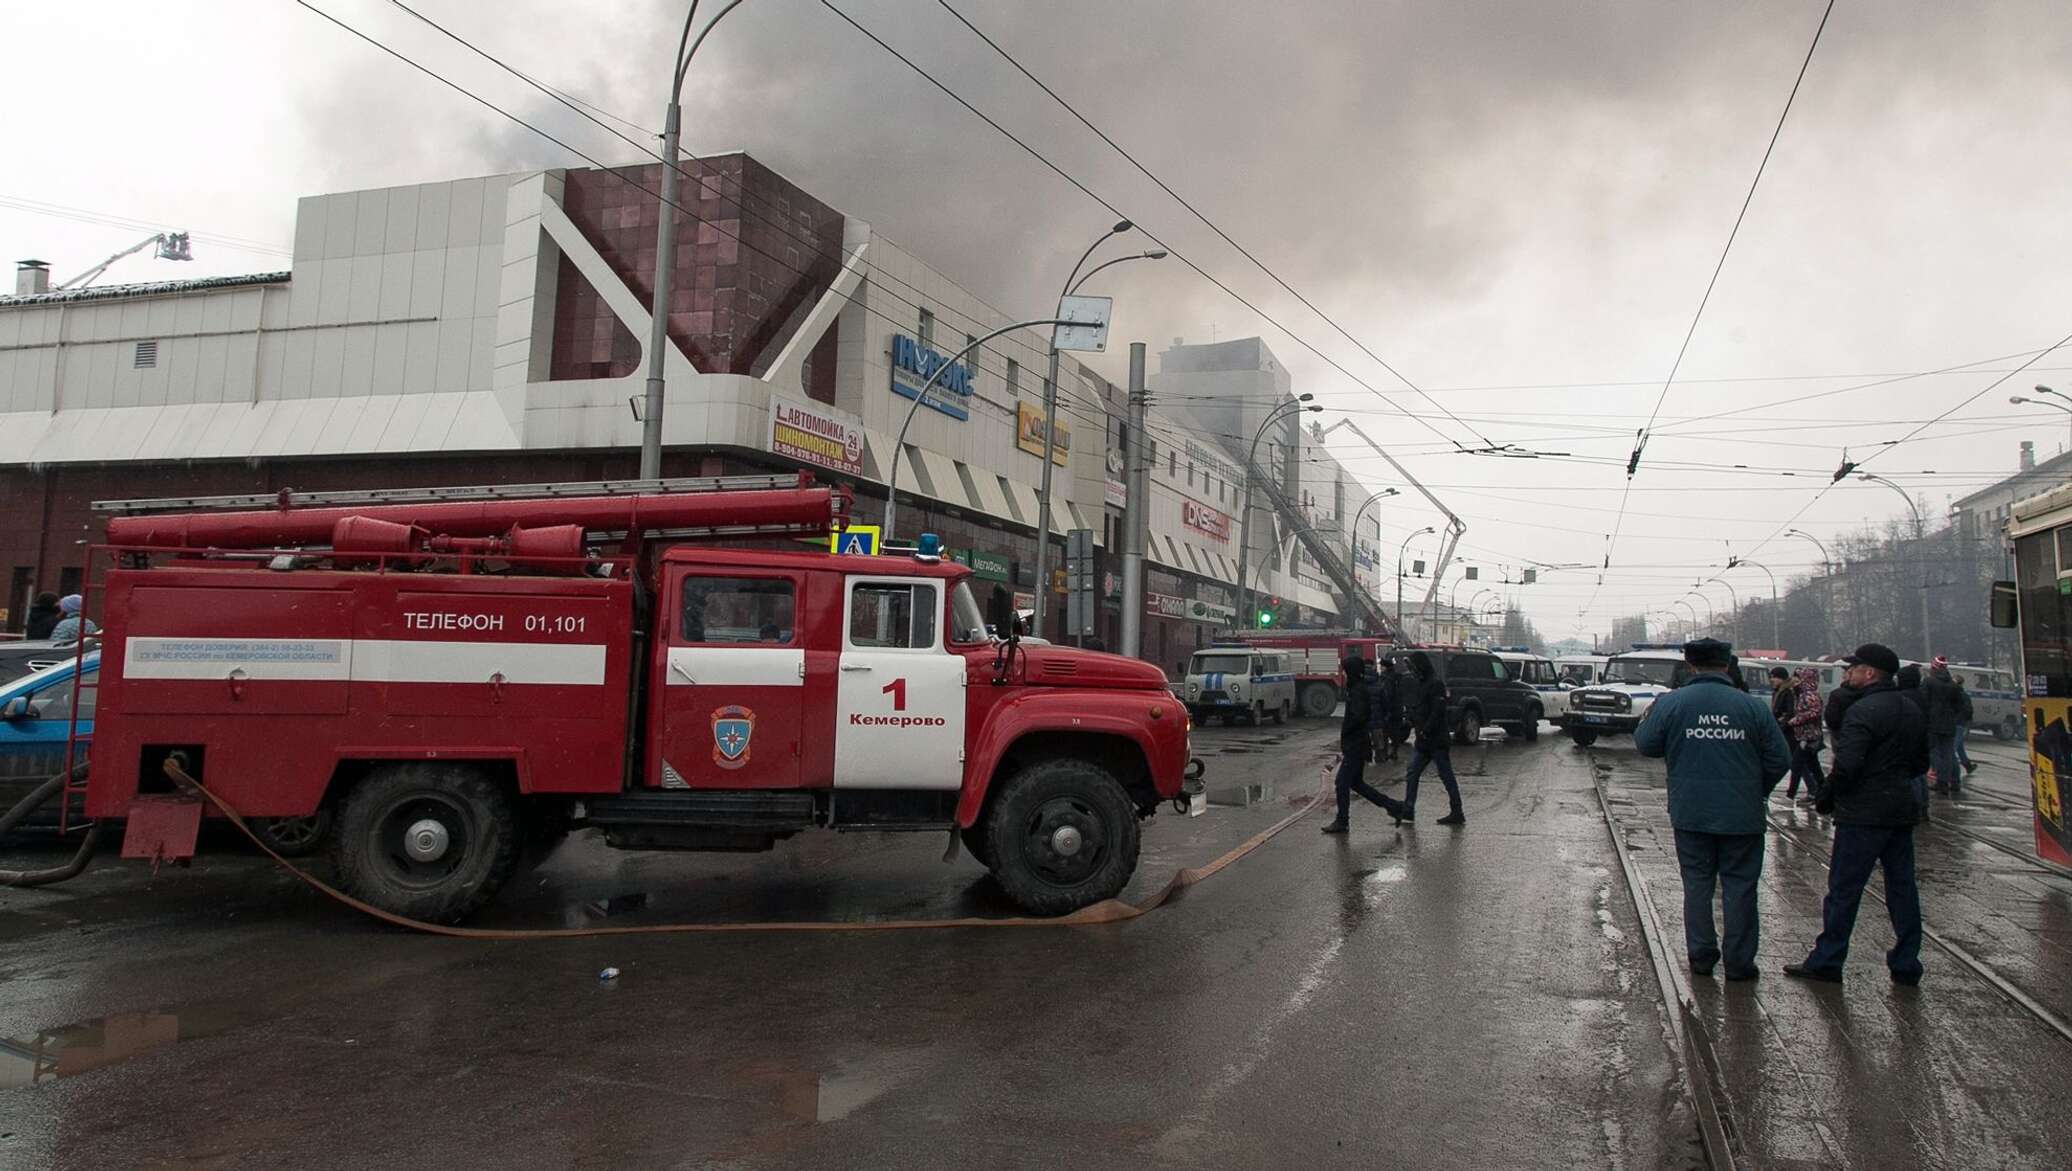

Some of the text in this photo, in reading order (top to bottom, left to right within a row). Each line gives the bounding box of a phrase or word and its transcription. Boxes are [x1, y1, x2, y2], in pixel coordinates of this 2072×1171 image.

[787, 407, 845, 441] АВТОМОЙКА
[775, 424, 845, 461] ШИНОМОНТАЖ
[847, 434, 858, 449] 24
[404, 612, 586, 635] ТЕЛЕФОН 01,101
[882, 678, 906, 711] 1
[849, 714, 946, 728] Кемерово
[1698, 714, 1729, 726] МЧС
[1685, 728, 1745, 740] РОССИИ
